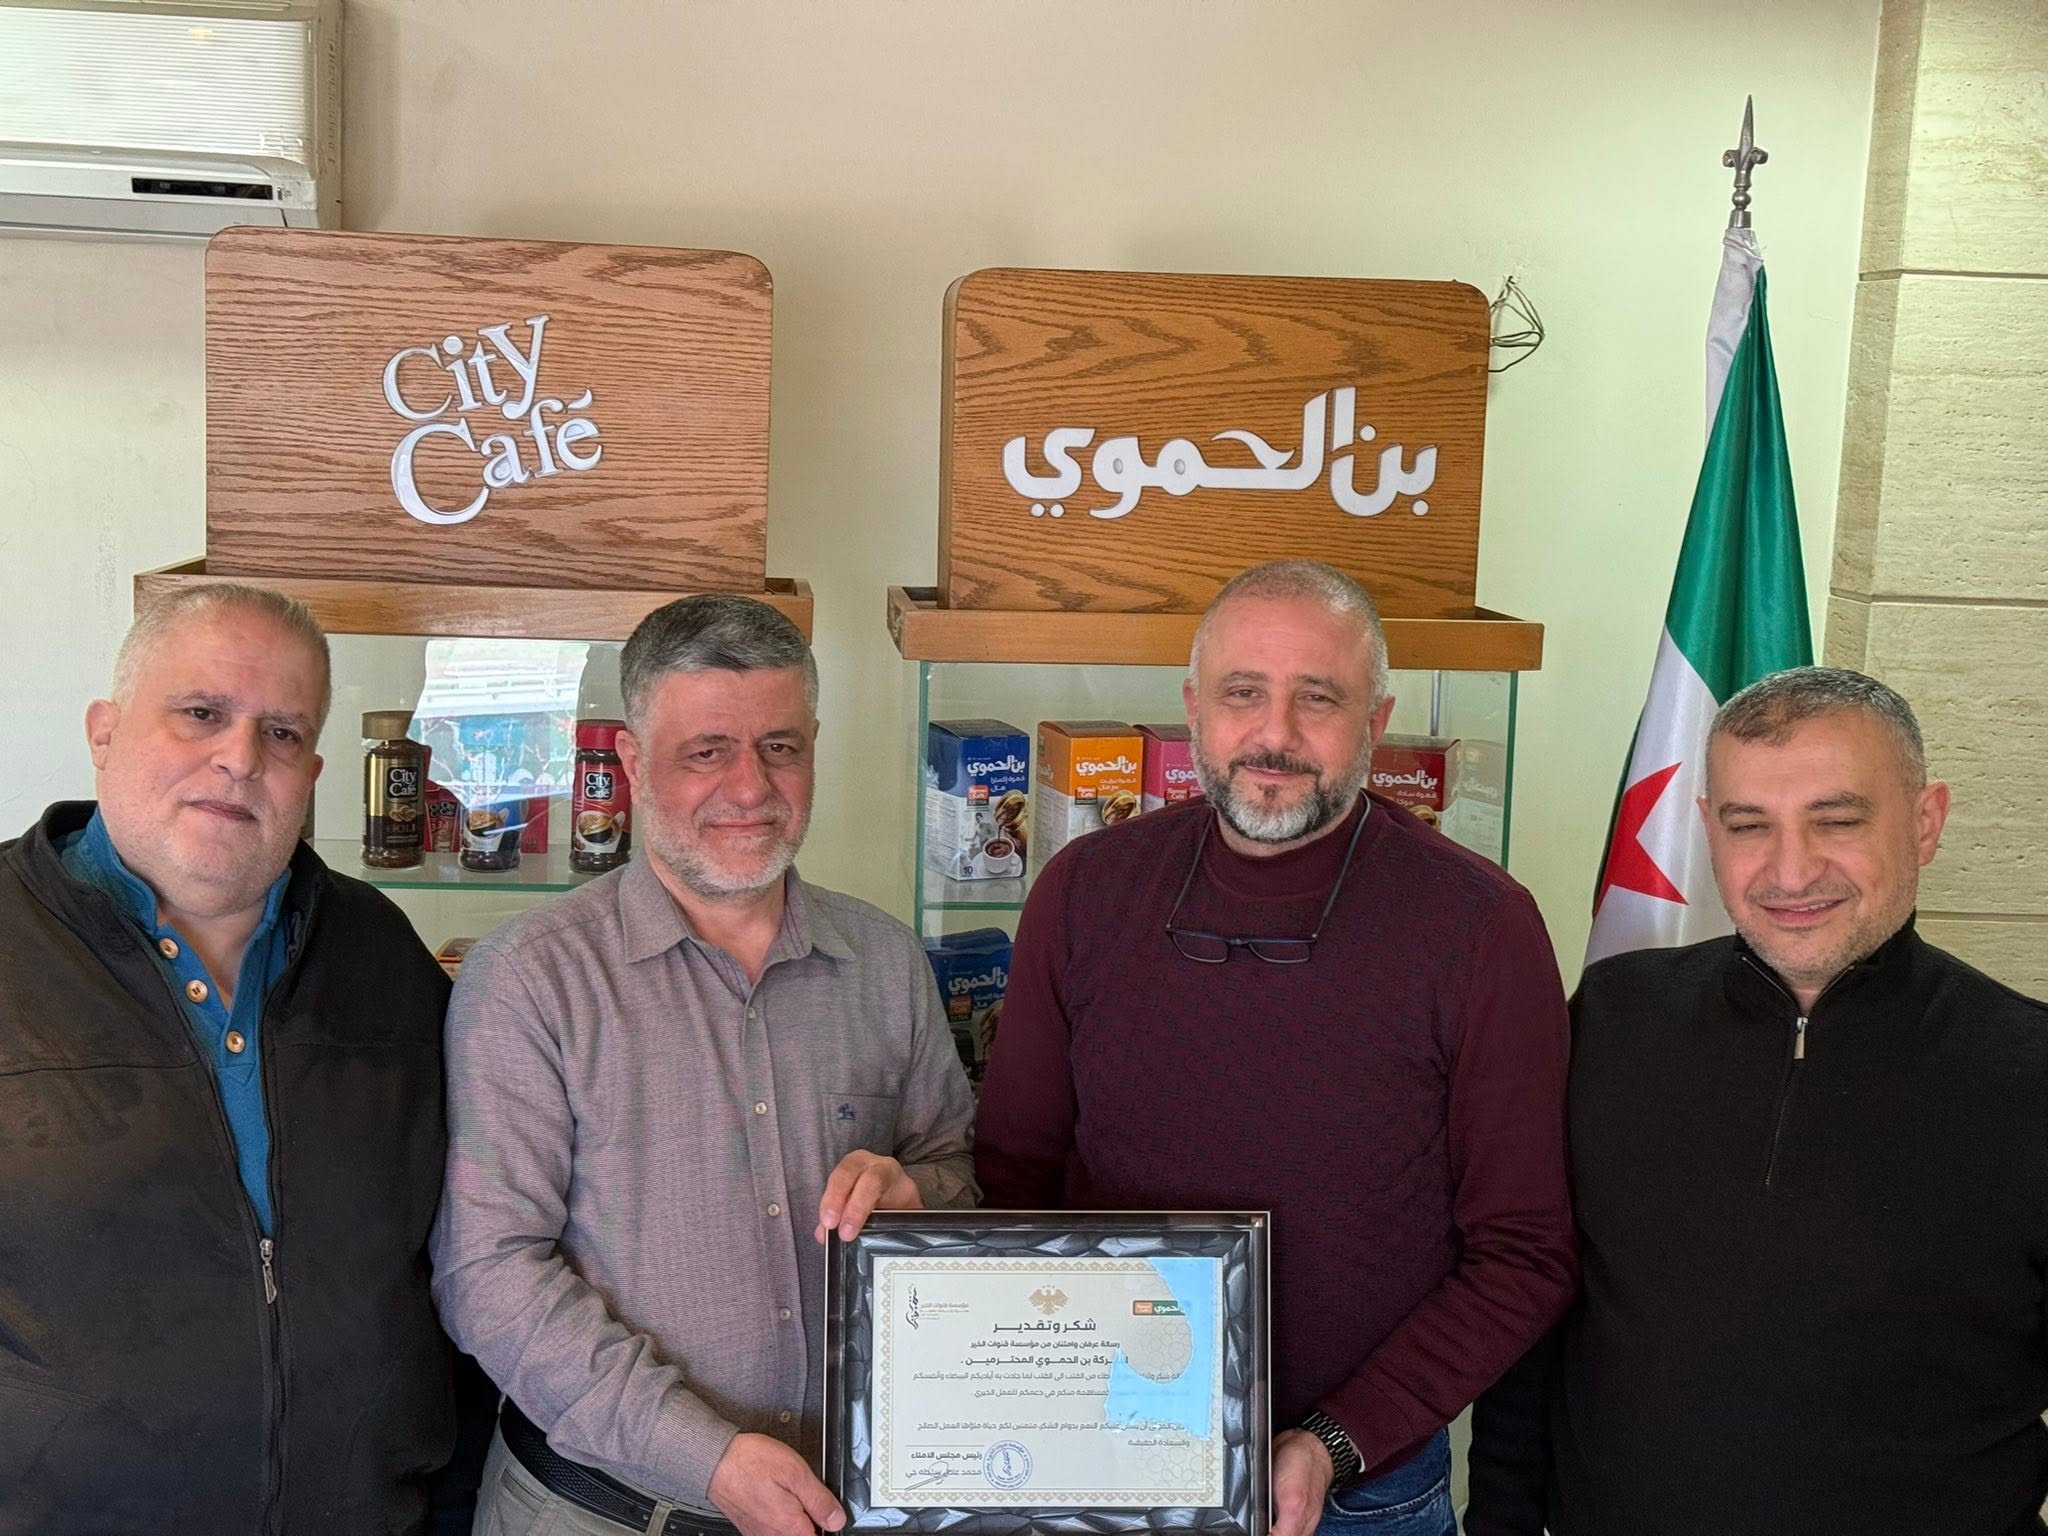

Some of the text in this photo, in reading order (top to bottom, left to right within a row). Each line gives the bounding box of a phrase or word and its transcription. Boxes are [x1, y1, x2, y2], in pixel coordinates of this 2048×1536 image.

[382, 315, 551, 421] City
[390, 387, 603, 525] Café
[1002, 386, 1438, 519] بن الحموي
[967, 755, 1015, 777] الحموي
[1011, 758, 1026, 773] بن
[1075, 755, 1126, 776] الحموي
[1122, 759, 1137, 774] بن
[390, 768, 417, 785] City
[586, 773, 611, 788] City
[1372, 769, 1426, 788] الحموي
[1421, 775, 1438, 790] بن
[962, 865, 974, 876] 10
[948, 966, 1001, 995] الحموي
[993, 1318, 1096, 1334] شكر وتقدير
[970, 1340, 1120, 1350] رسالة عرفان وامتنان من مؤسسة قنوات الخير
[1035, 1356, 1078, 1367] الحموي
[1080, 1357, 1091, 1367] بن
[1085, 1374, 1097, 1382] من
[998, 1422, 1012, 1431] لكم
[936, 1451, 961, 1461] مجلس
[962, 1451, 983, 1461] رئيس
